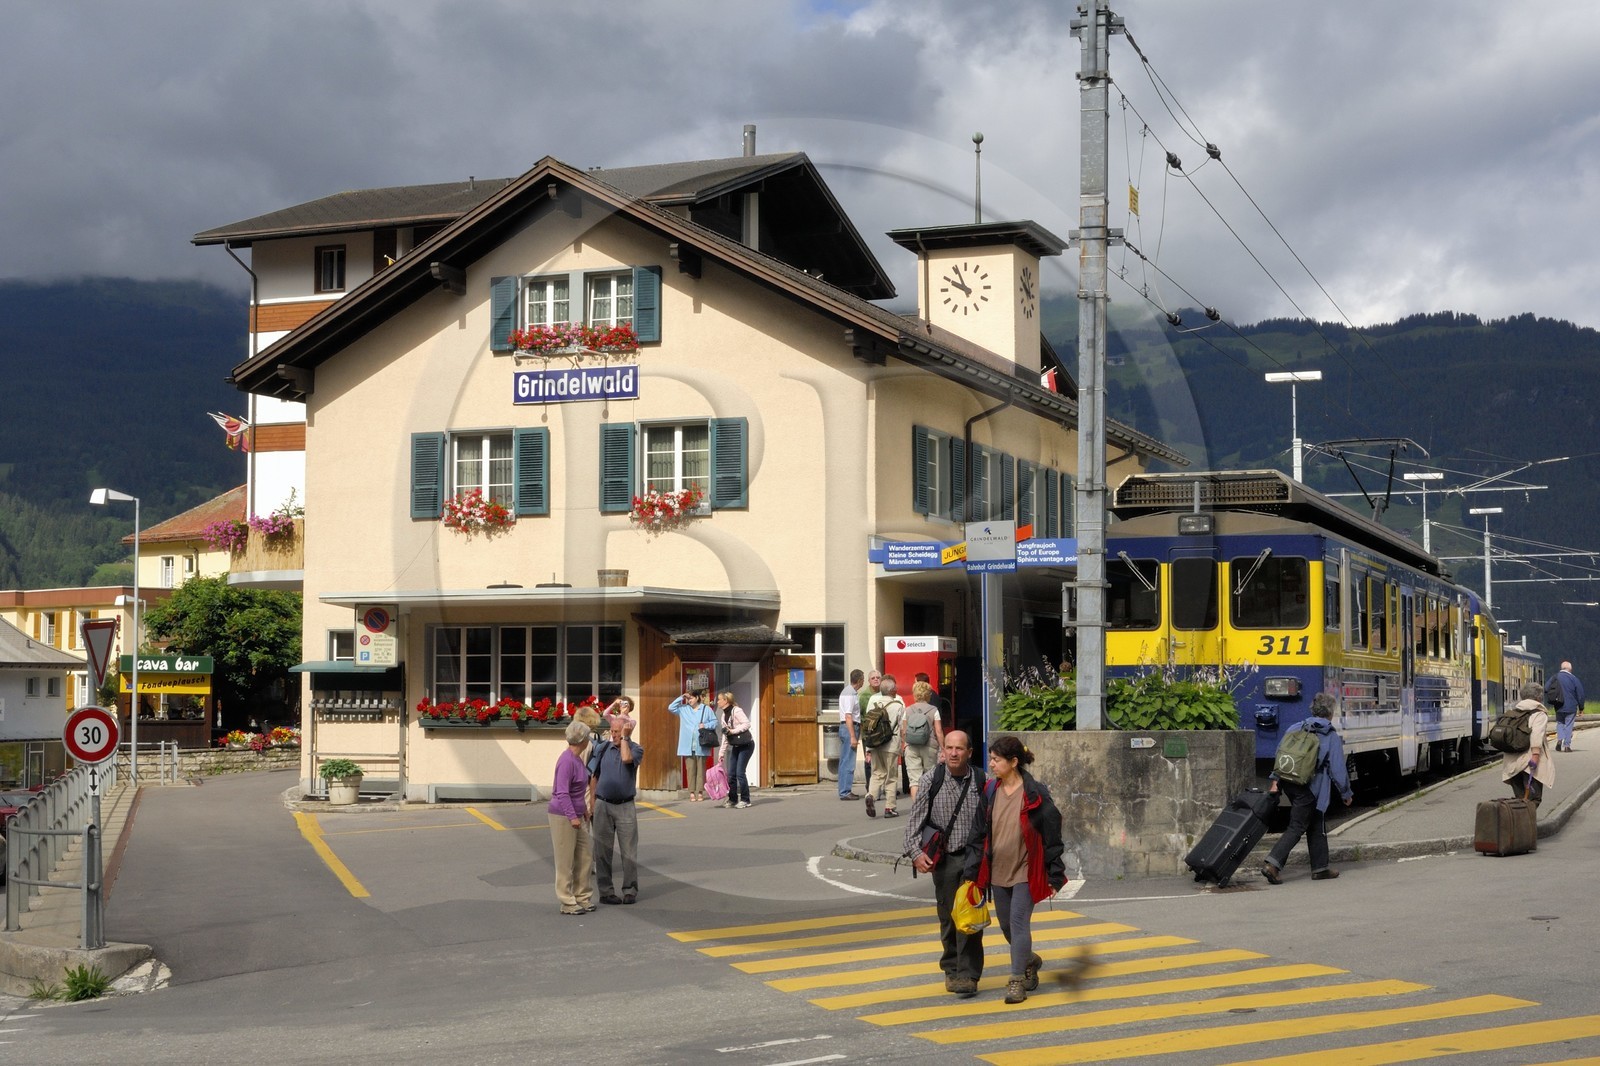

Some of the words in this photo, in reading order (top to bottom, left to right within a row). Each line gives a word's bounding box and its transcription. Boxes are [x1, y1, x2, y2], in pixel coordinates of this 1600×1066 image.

[518, 369, 634, 398] Grindelwald
[1017, 542, 1056, 550] Jungfraujoch
[967, 563, 986, 571] Bahnhof
[987, 562, 1015, 570] Grindelwald
[1257, 635, 1310, 656] 311
[137, 659, 168, 671] cava
[175, 657, 199, 671] bar
[141, 675, 205, 690] Fondueplausch
[81, 726, 101, 745] 30
